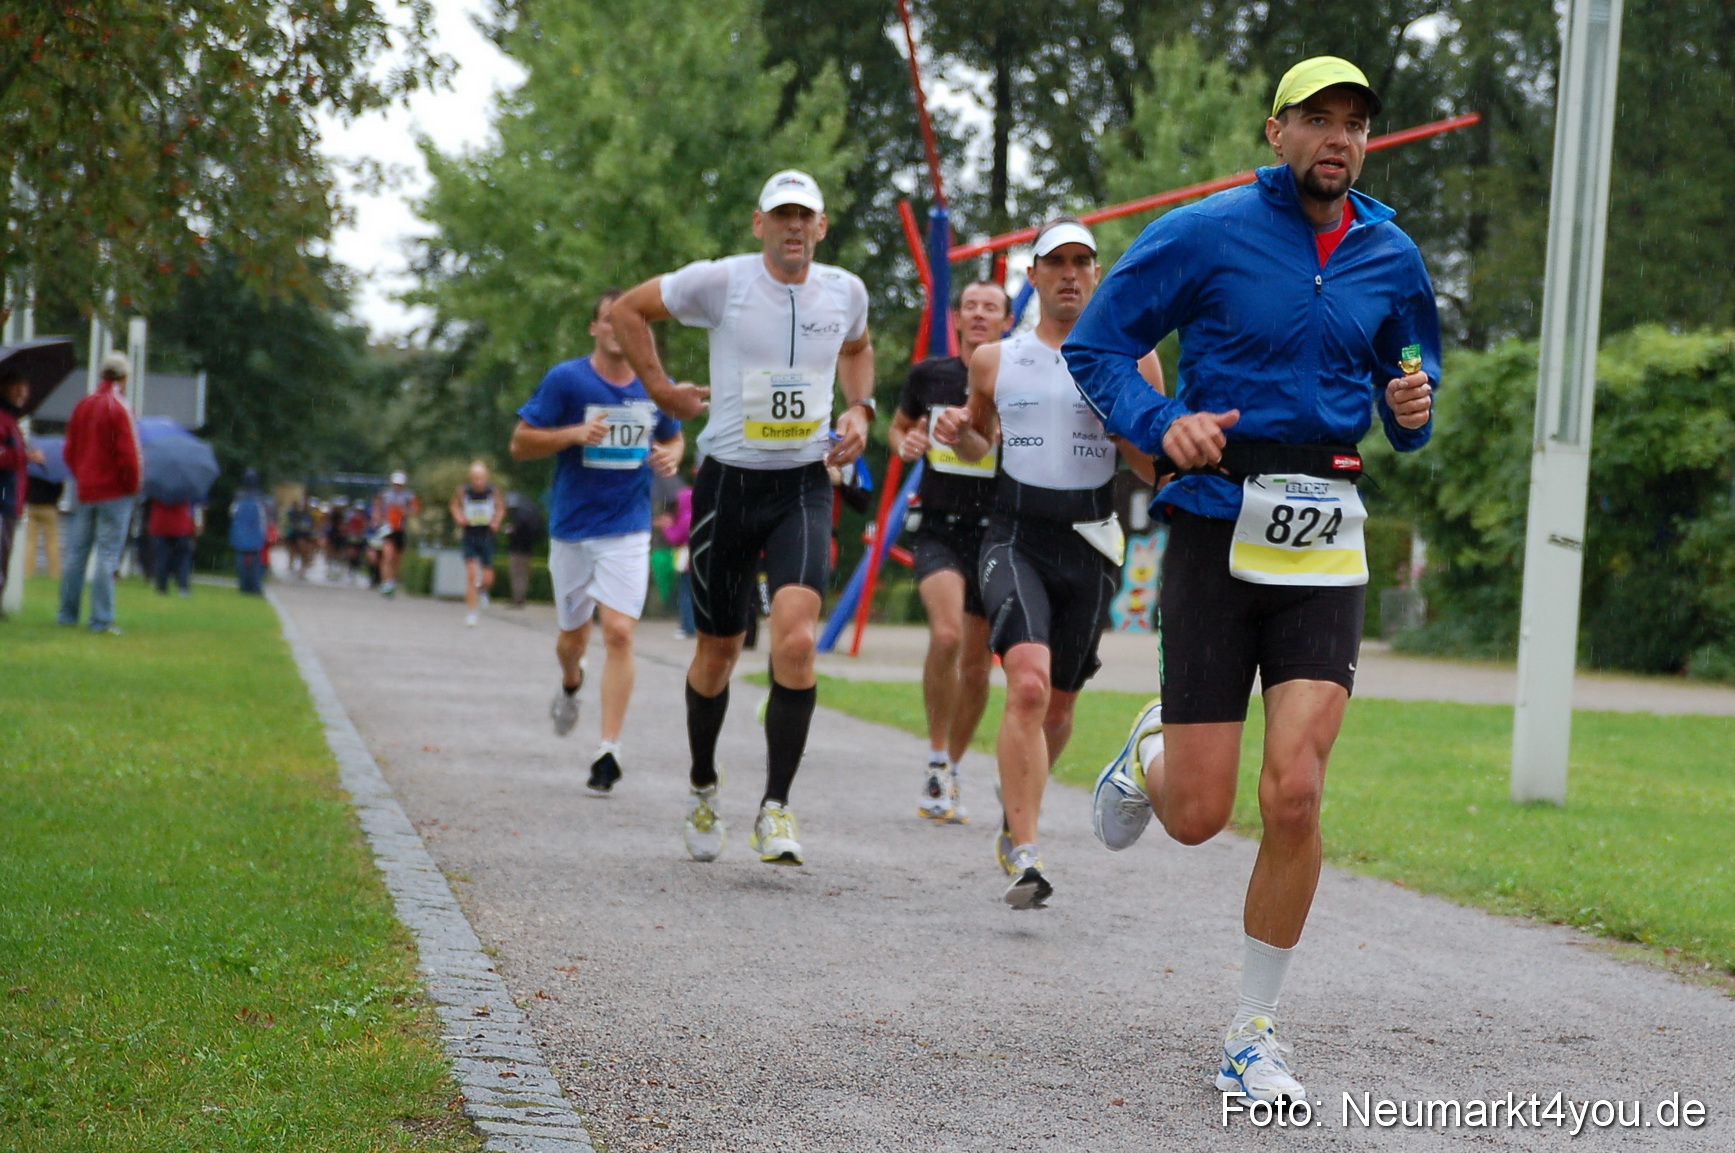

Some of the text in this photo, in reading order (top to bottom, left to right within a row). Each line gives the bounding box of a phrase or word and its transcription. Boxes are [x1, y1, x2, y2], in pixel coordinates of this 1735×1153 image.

[771, 390, 805, 420] 85
[762, 426, 812, 438] Christian
[1072, 431, 1098, 441] Made
[1073, 444, 1108, 458] ITALY
[1265, 504, 1343, 548] 824
